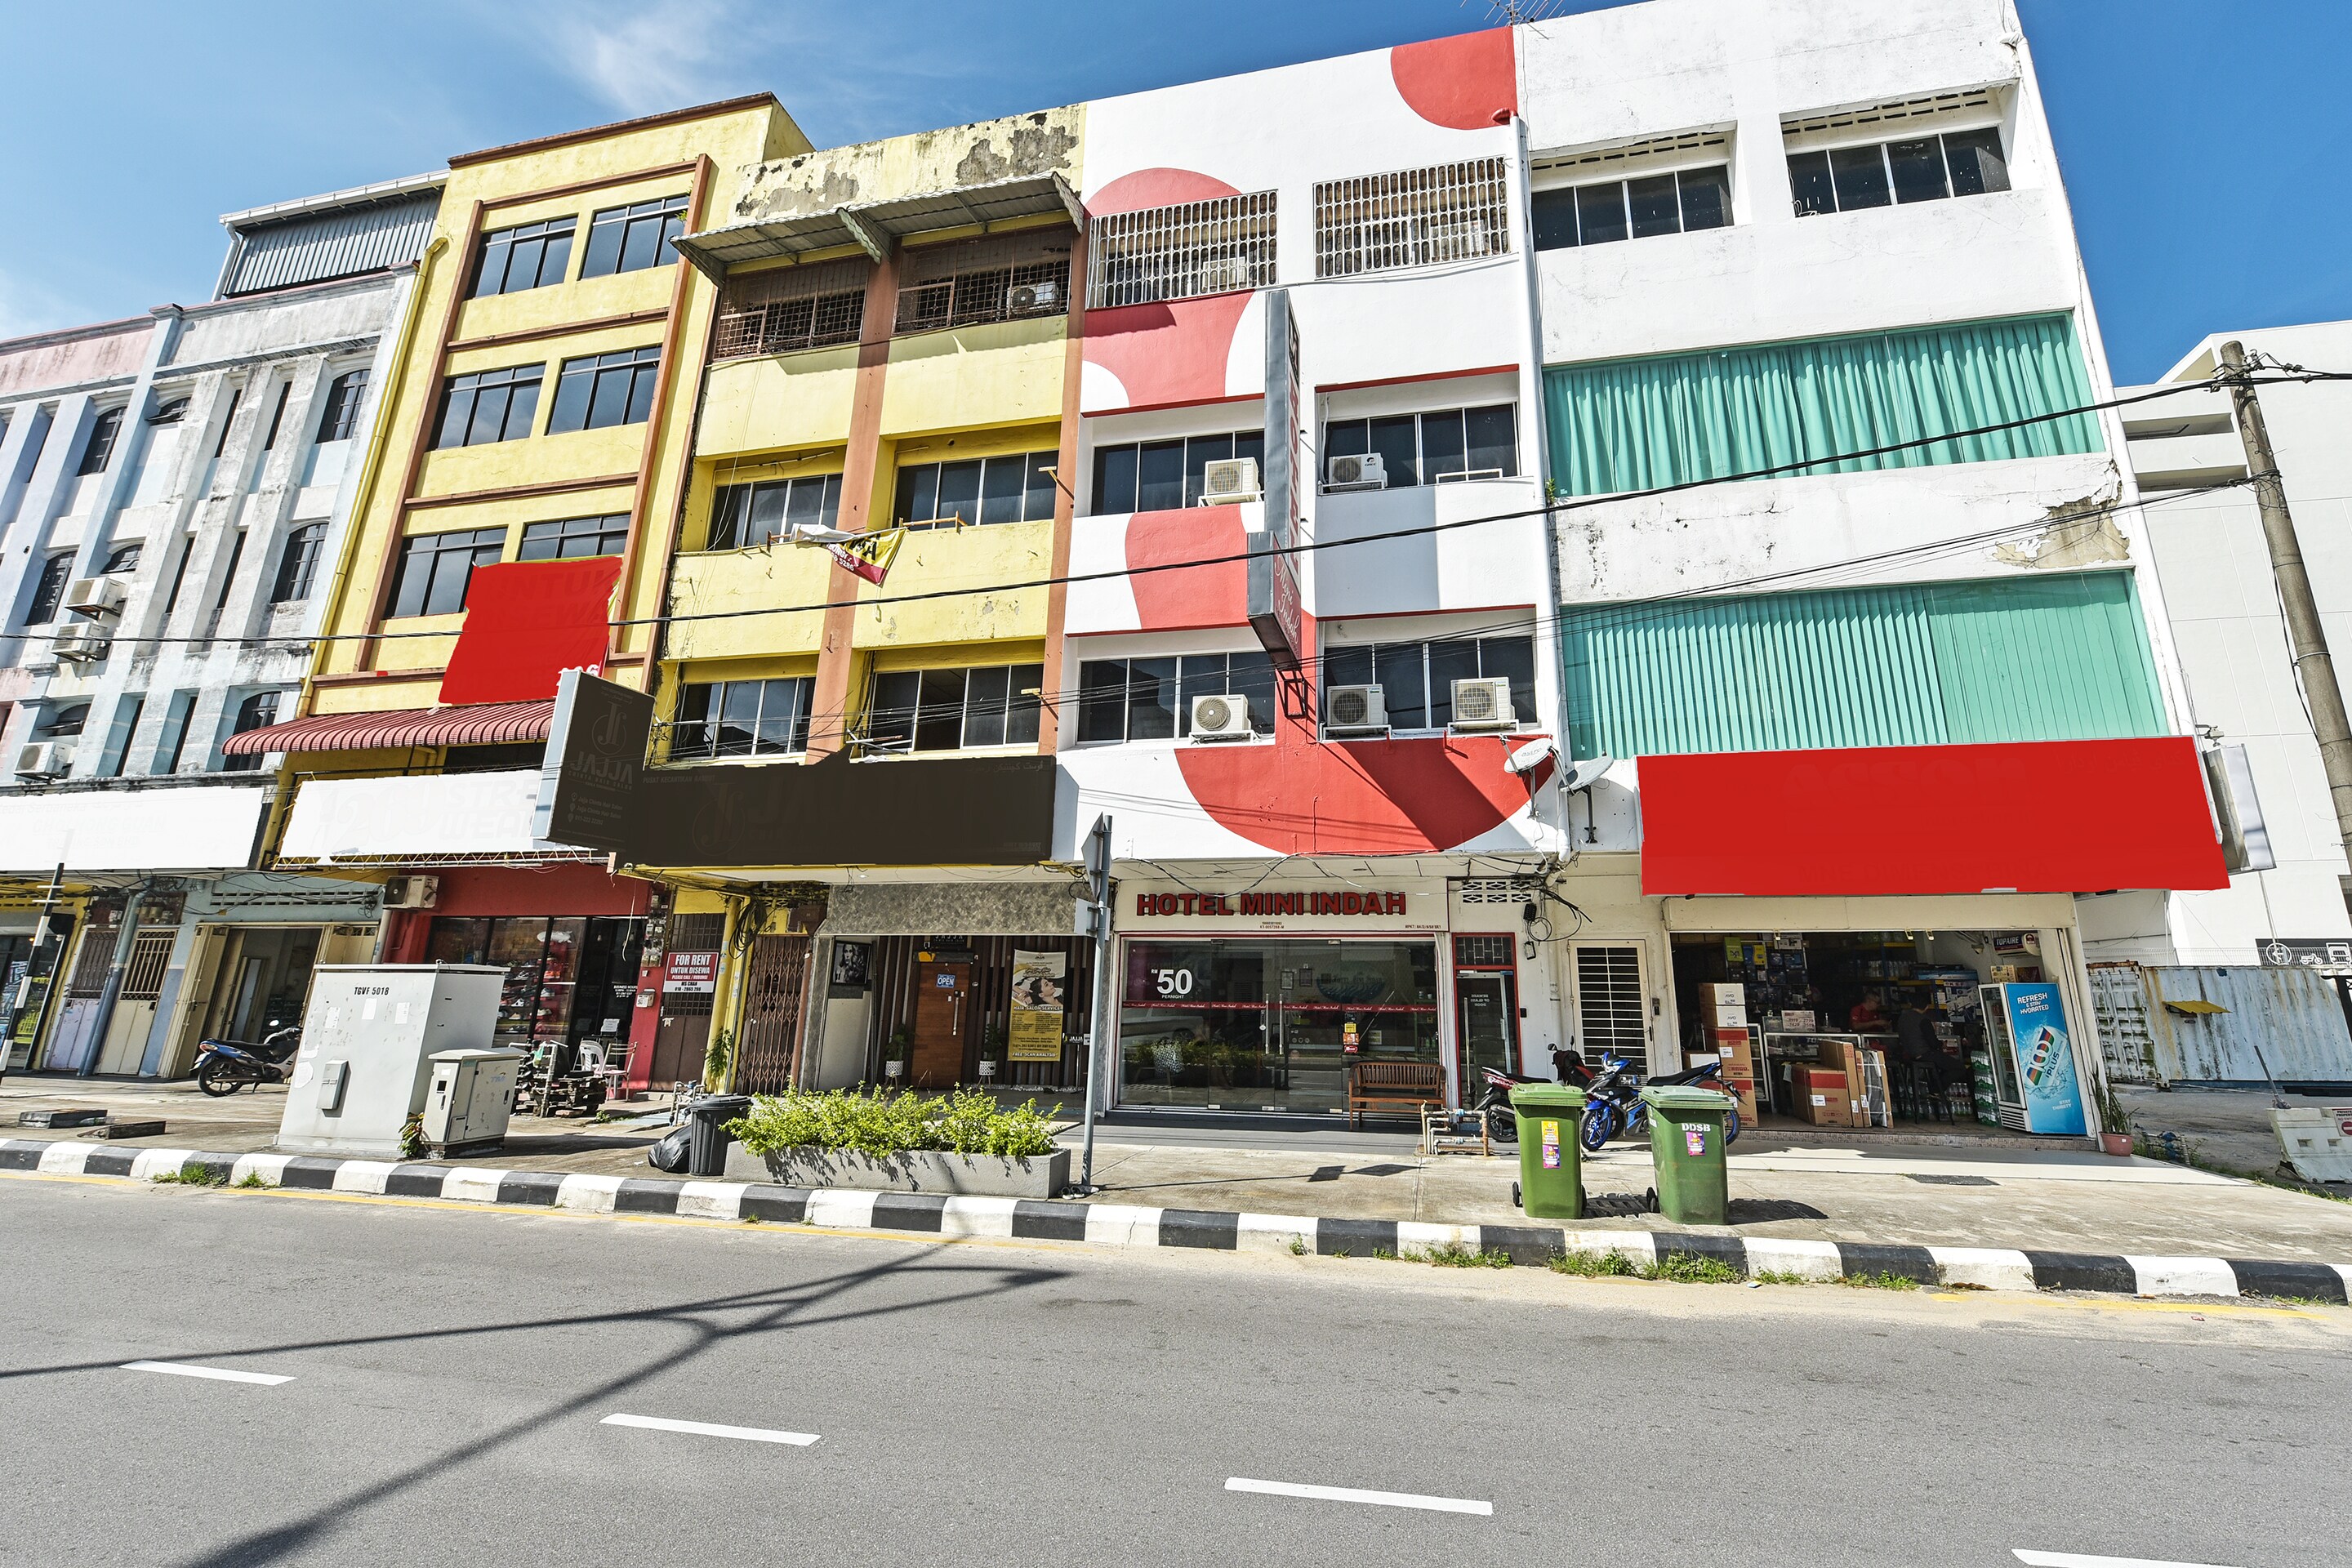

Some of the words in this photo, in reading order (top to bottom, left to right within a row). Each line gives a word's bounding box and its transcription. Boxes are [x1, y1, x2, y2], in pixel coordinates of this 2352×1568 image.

[1290, 371, 1299, 573] HOTEL
[1136, 893, 1234, 915] HOTEL
[1240, 892, 1304, 915] MINI
[1310, 891, 1406, 915] INDAH
[1995, 936, 2020, 946] TOPAIRE
[675, 954, 690, 965] FOR
[691, 954, 711, 965] RENT
[670, 966, 688, 974] UNTUK
[688, 966, 710, 974] DISEWA
[938, 978, 954, 986] OPEN
[1156, 969, 1192, 995] 50
[354, 987, 371, 996] TGVF
[372, 987, 390, 996] 5018
[2017, 992, 2048, 1004] REFRESH
[2020, 1004, 2049, 1014] HYDRATED
[1682, 1123, 1711, 1132] DDSB
